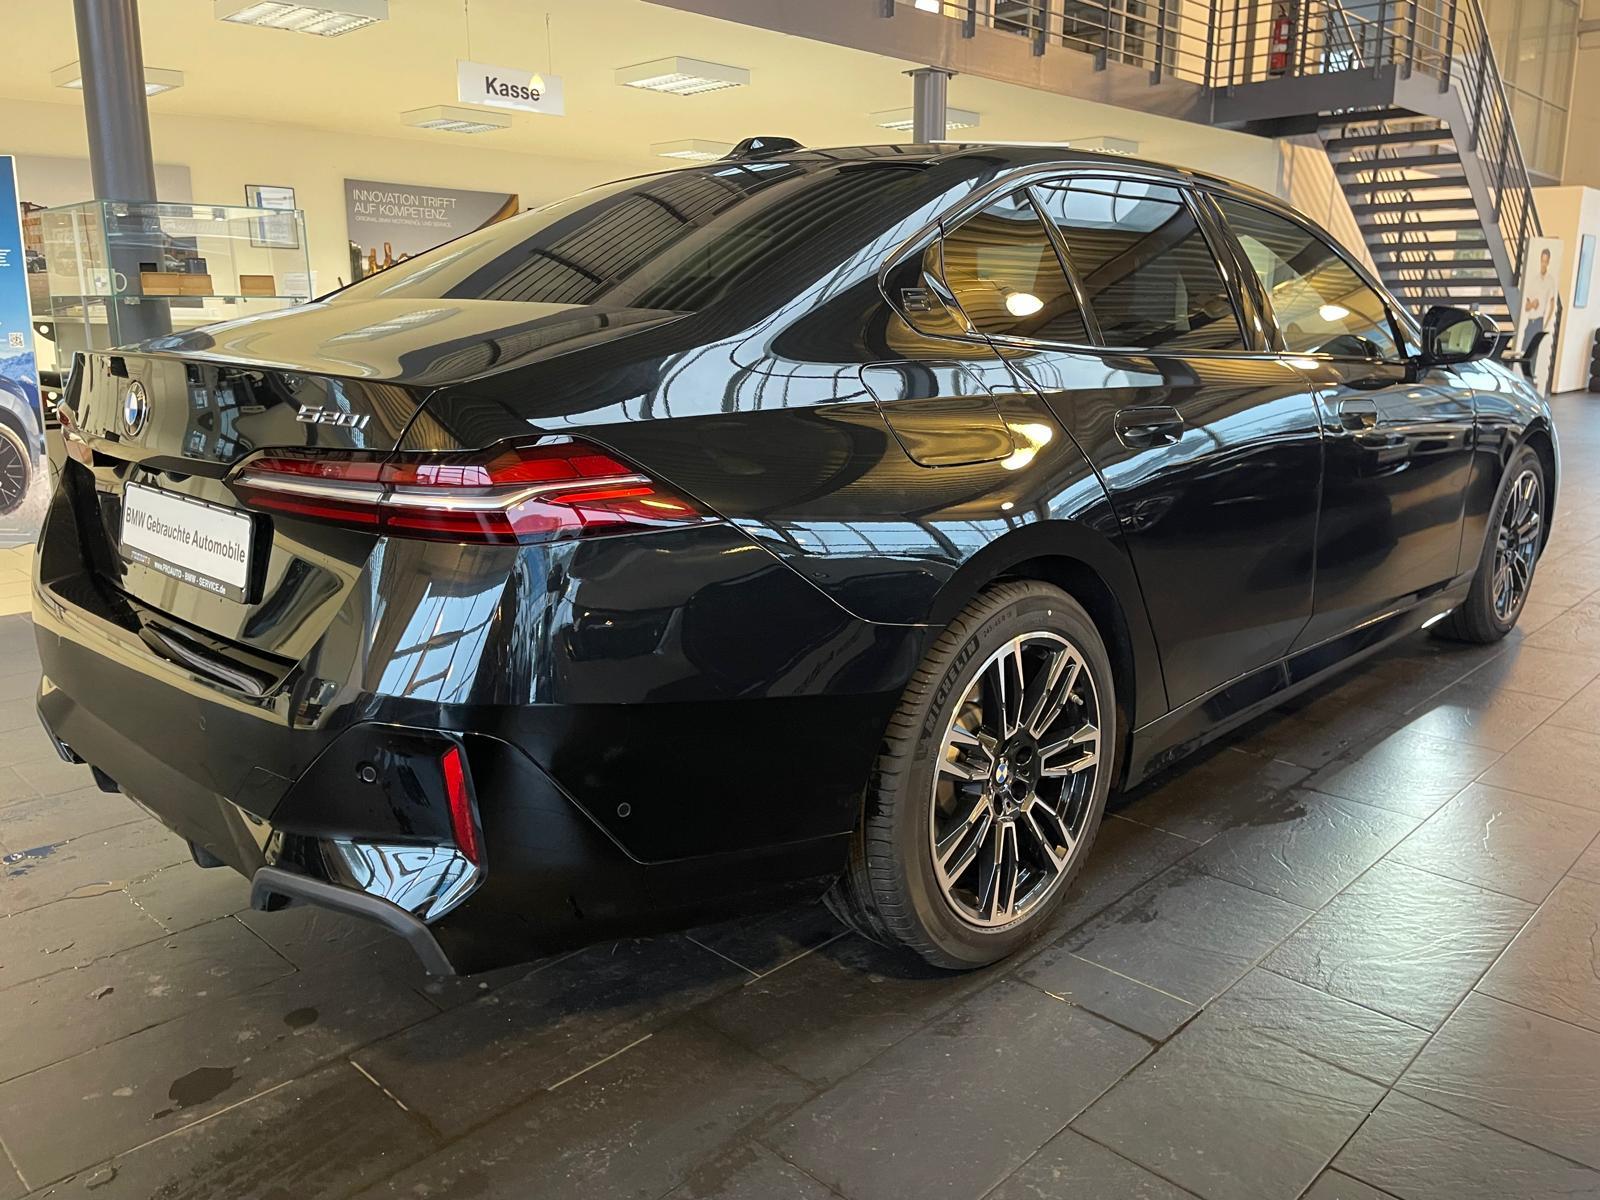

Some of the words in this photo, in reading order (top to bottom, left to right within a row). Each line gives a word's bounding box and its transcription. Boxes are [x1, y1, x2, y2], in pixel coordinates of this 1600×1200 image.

[485, 76, 540, 101] Kasse
[353, 189, 419, 206] INNOVATION
[422, 196, 457, 208] TRIFFT
[354, 202, 377, 214] AUF
[296, 404, 371, 430] 520i
[126, 507, 147, 528] BMW
[146, 514, 191, 545] Gebrauchte
[192, 530, 246, 563] Automobile
[923, 638, 978, 731] MICHELIN
